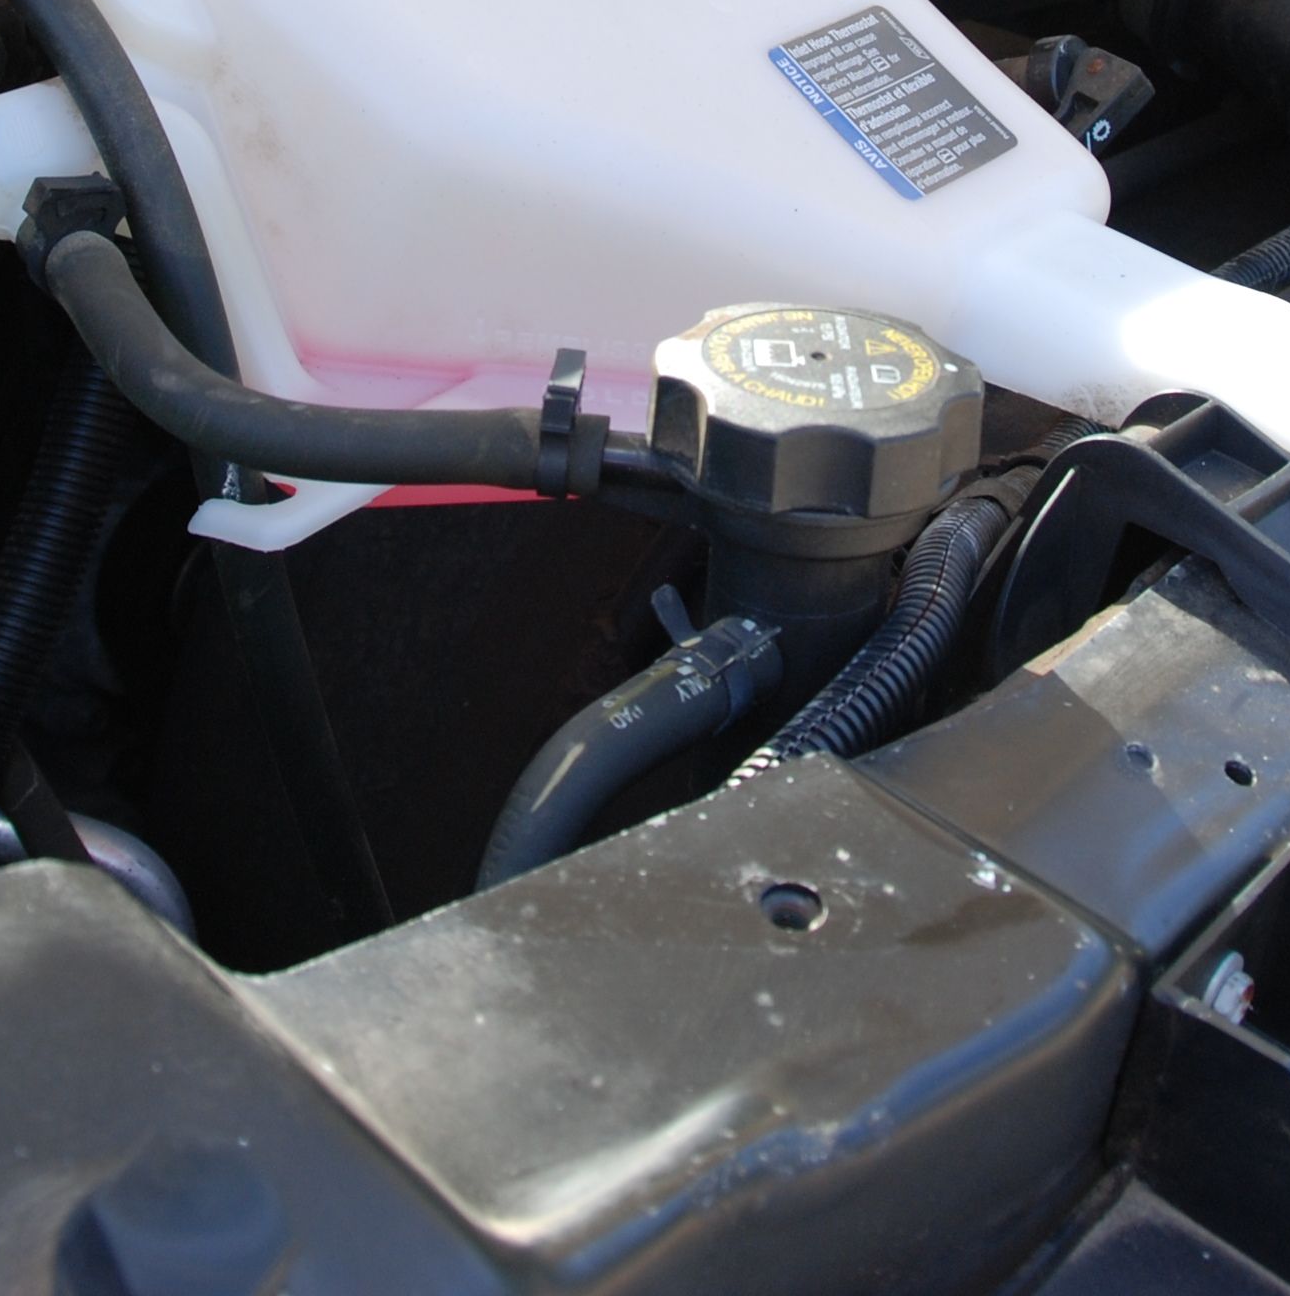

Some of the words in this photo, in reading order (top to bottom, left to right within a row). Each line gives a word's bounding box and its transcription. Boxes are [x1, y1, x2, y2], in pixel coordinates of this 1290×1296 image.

[788, 41, 810, 58] Inlet
[808, 32, 832, 51] Hose
[829, 13, 880, 41] Thermostat
[843, 39, 856, 53] can
[855, 34, 877, 50] cause
[776, 57, 823, 105] NOTICE
[821, 76, 849, 94] Service
[846, 64, 875, 82] Manual
[844, 90, 894, 119] Thermostat
[892, 87, 905, 100] et
[901, 72, 936, 95] flexible
[920, 99, 952, 120] incorrect
[859, 103, 910, 133] d'admission
[854, 138, 888, 170] AVIS
